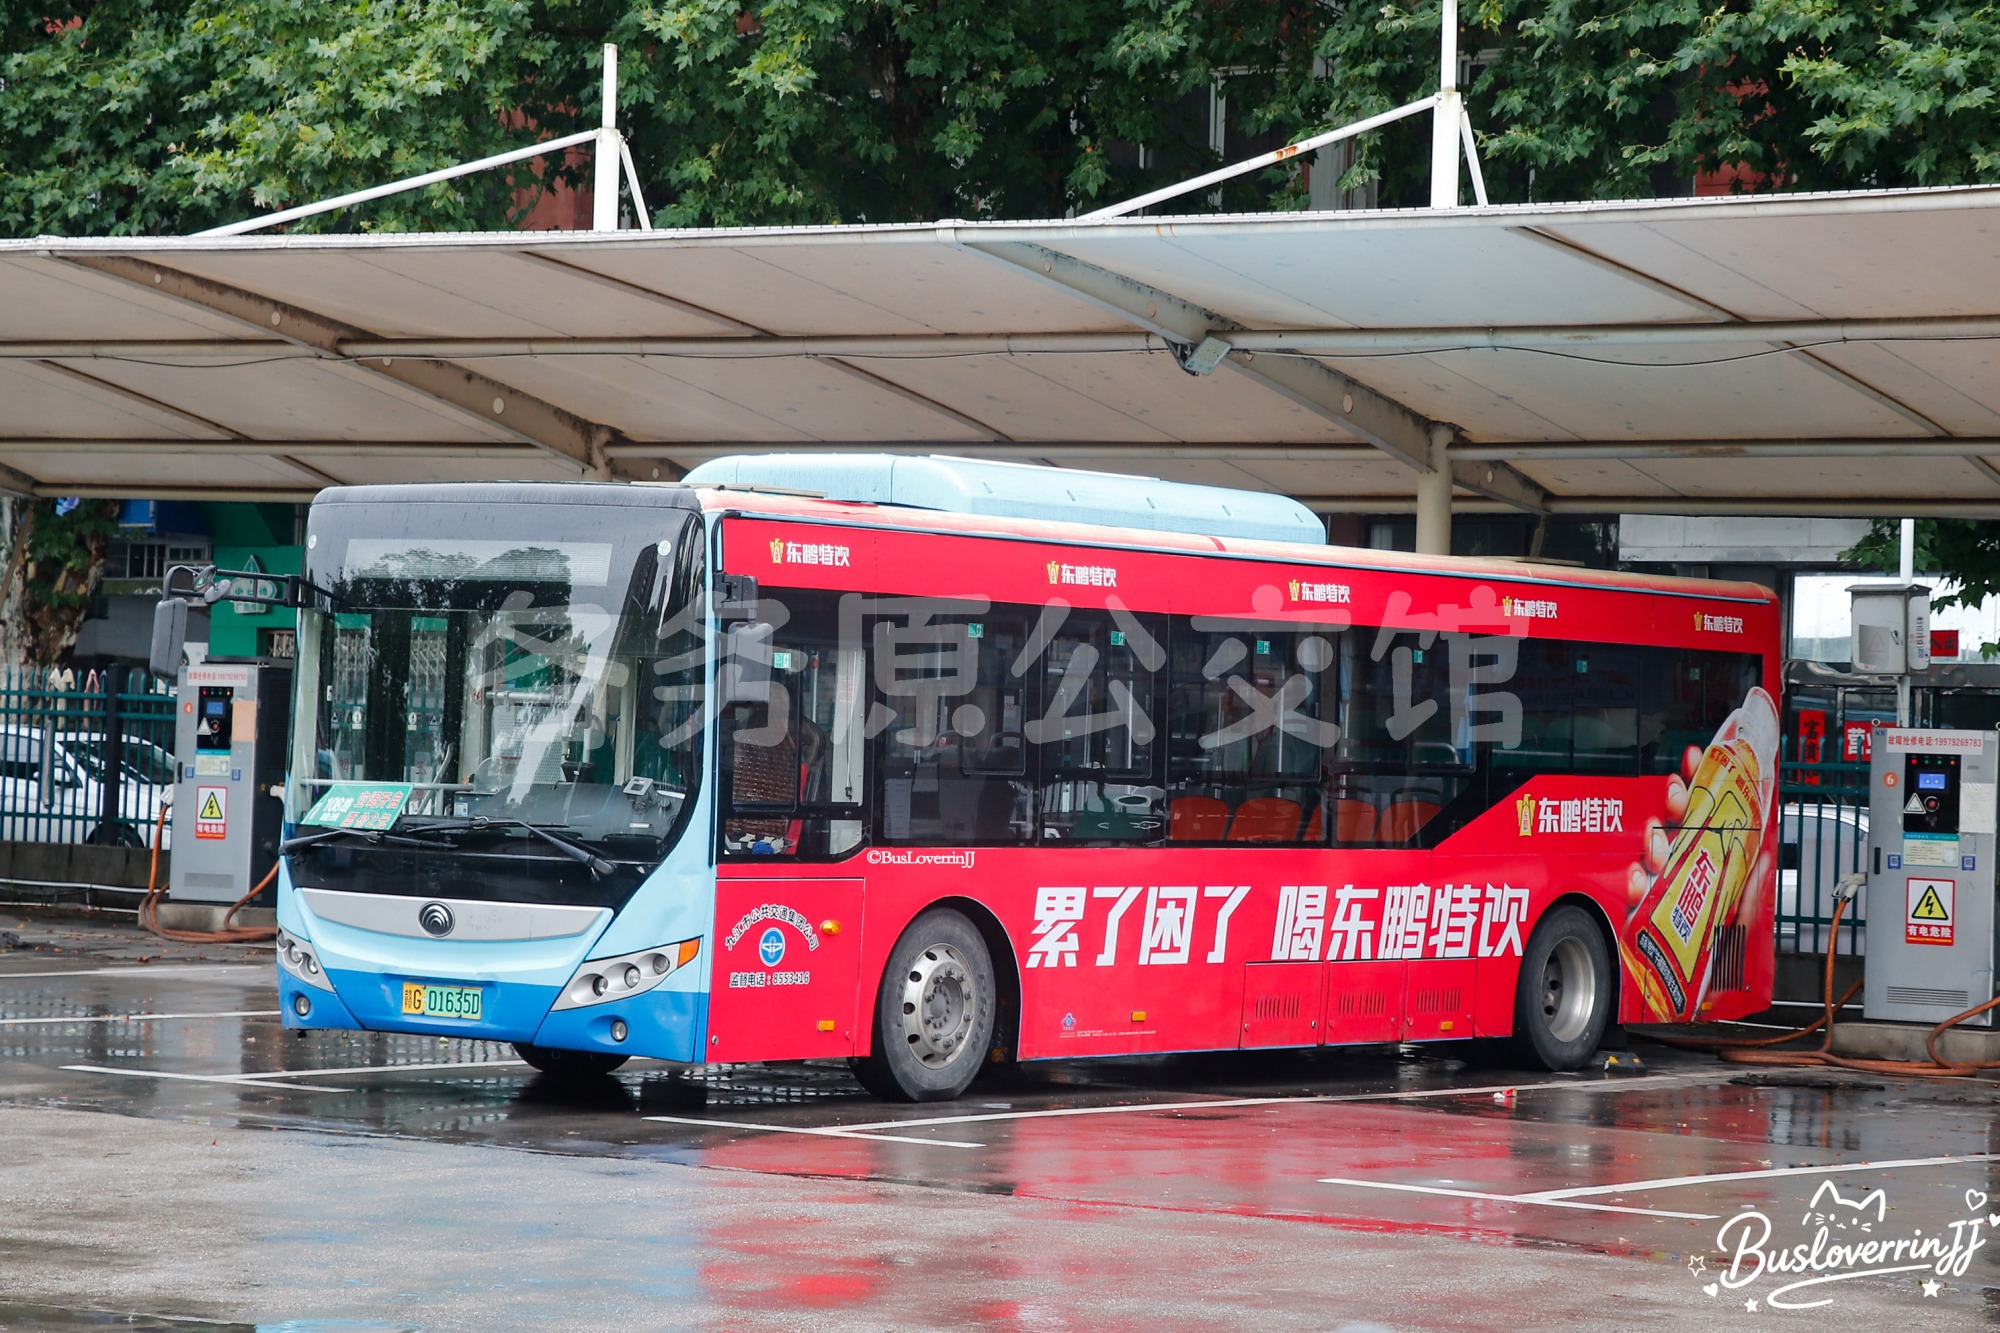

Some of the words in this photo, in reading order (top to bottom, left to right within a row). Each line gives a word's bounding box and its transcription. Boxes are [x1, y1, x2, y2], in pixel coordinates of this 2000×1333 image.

[786, 541, 851, 568] 东鹏特饮
[1061, 563, 1118, 588] 东鹏特饮
[1301, 581, 1351, 604] 东鹏特饮
[1513, 598, 1558, 619] 东鹏特饮
[1703, 613, 1744, 634] 东鹏特饮
[1887, 774, 1894, 785] 6
[340, 811, 392, 830] 票价2元
[1538, 797, 1623, 833] 东鹏特饮
[1677, 849, 1716, 928] 东鹏
[725, 904, 819, 951] 九江市公共交通集团公司
[1026, 886, 1252, 968] 累了困了
[1270, 882, 1528, 961] 喝东鹏特饮
[1907, 925, 1952, 938] 有电危险
